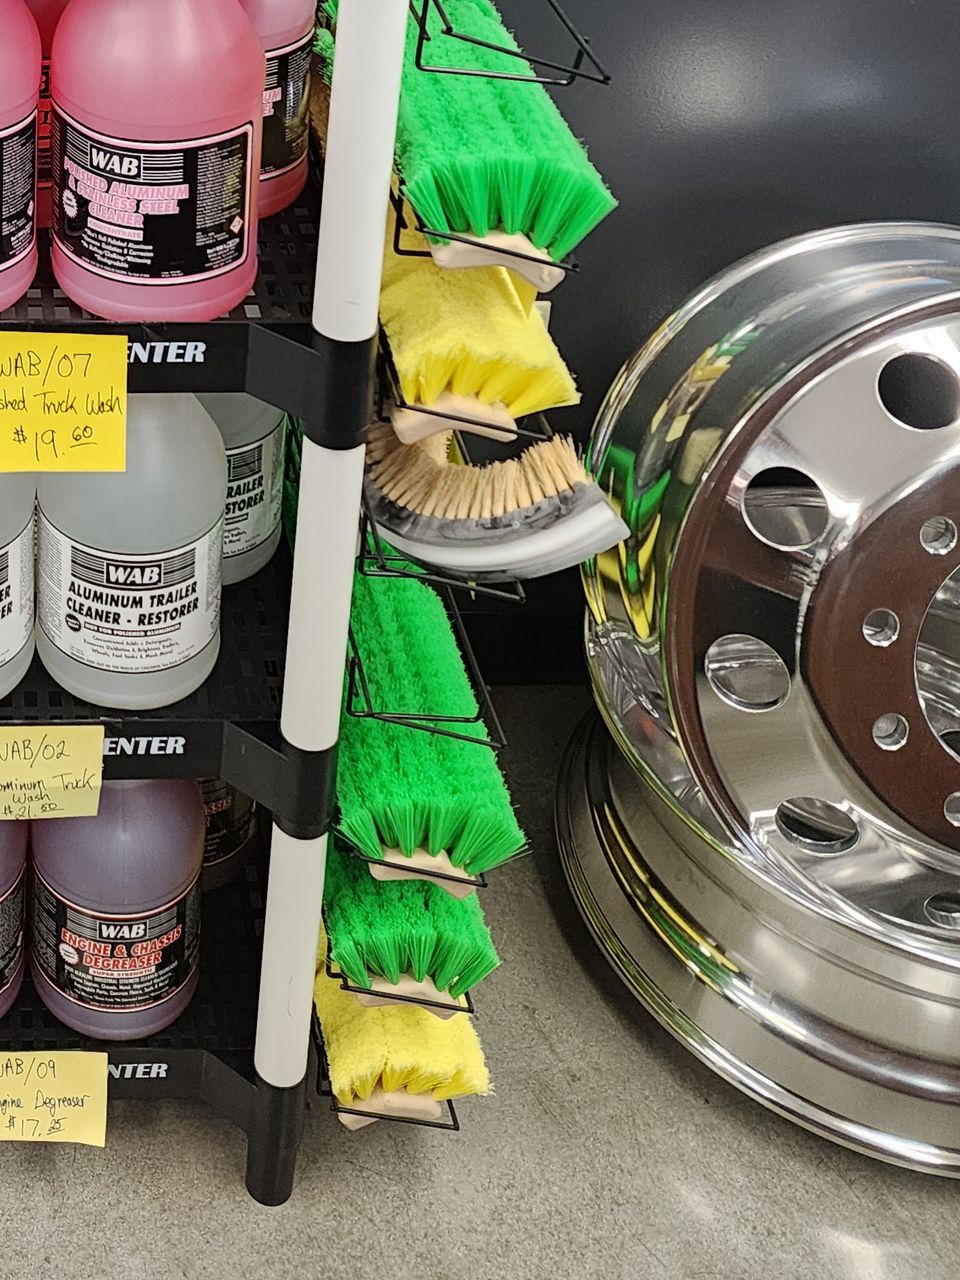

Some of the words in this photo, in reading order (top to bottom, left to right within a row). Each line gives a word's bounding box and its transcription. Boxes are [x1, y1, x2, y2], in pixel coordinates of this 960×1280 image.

[91, 148, 139, 176] WAB
[63, 155, 109, 192] POLISHED
[109, 181, 190, 200] ALUMINUM
[76, 181, 138, 213] STAINLESS
[138, 199, 180, 216] STEEL
[88, 201, 145, 228] CLEANER
[33, 390, 79, 417] Truck
[84, 385, 124, 416] Wash
[13, 425, 27, 445] $
[108, 564, 160, 584] WAB
[68, 581, 143, 609] ALUMINUM
[149, 581, 197, 608] TRAILER
[66, 597, 121, 625] CLEANER
[137, 596, 199, 626] RESTORER
[103, 736, 187, 756] ENTER
[52, 770, 98, 792] Truck
[12, 790, 51, 805] Wash
[61, 927, 112, 957] ENGINE
[113, 943, 128, 958] &
[130, 923, 183, 957] CHASSIS
[100, 923, 146, 939] WAB
[82, 950, 163, 971] DEGREASER
[34, 1089, 91, 1117] Degreaser
